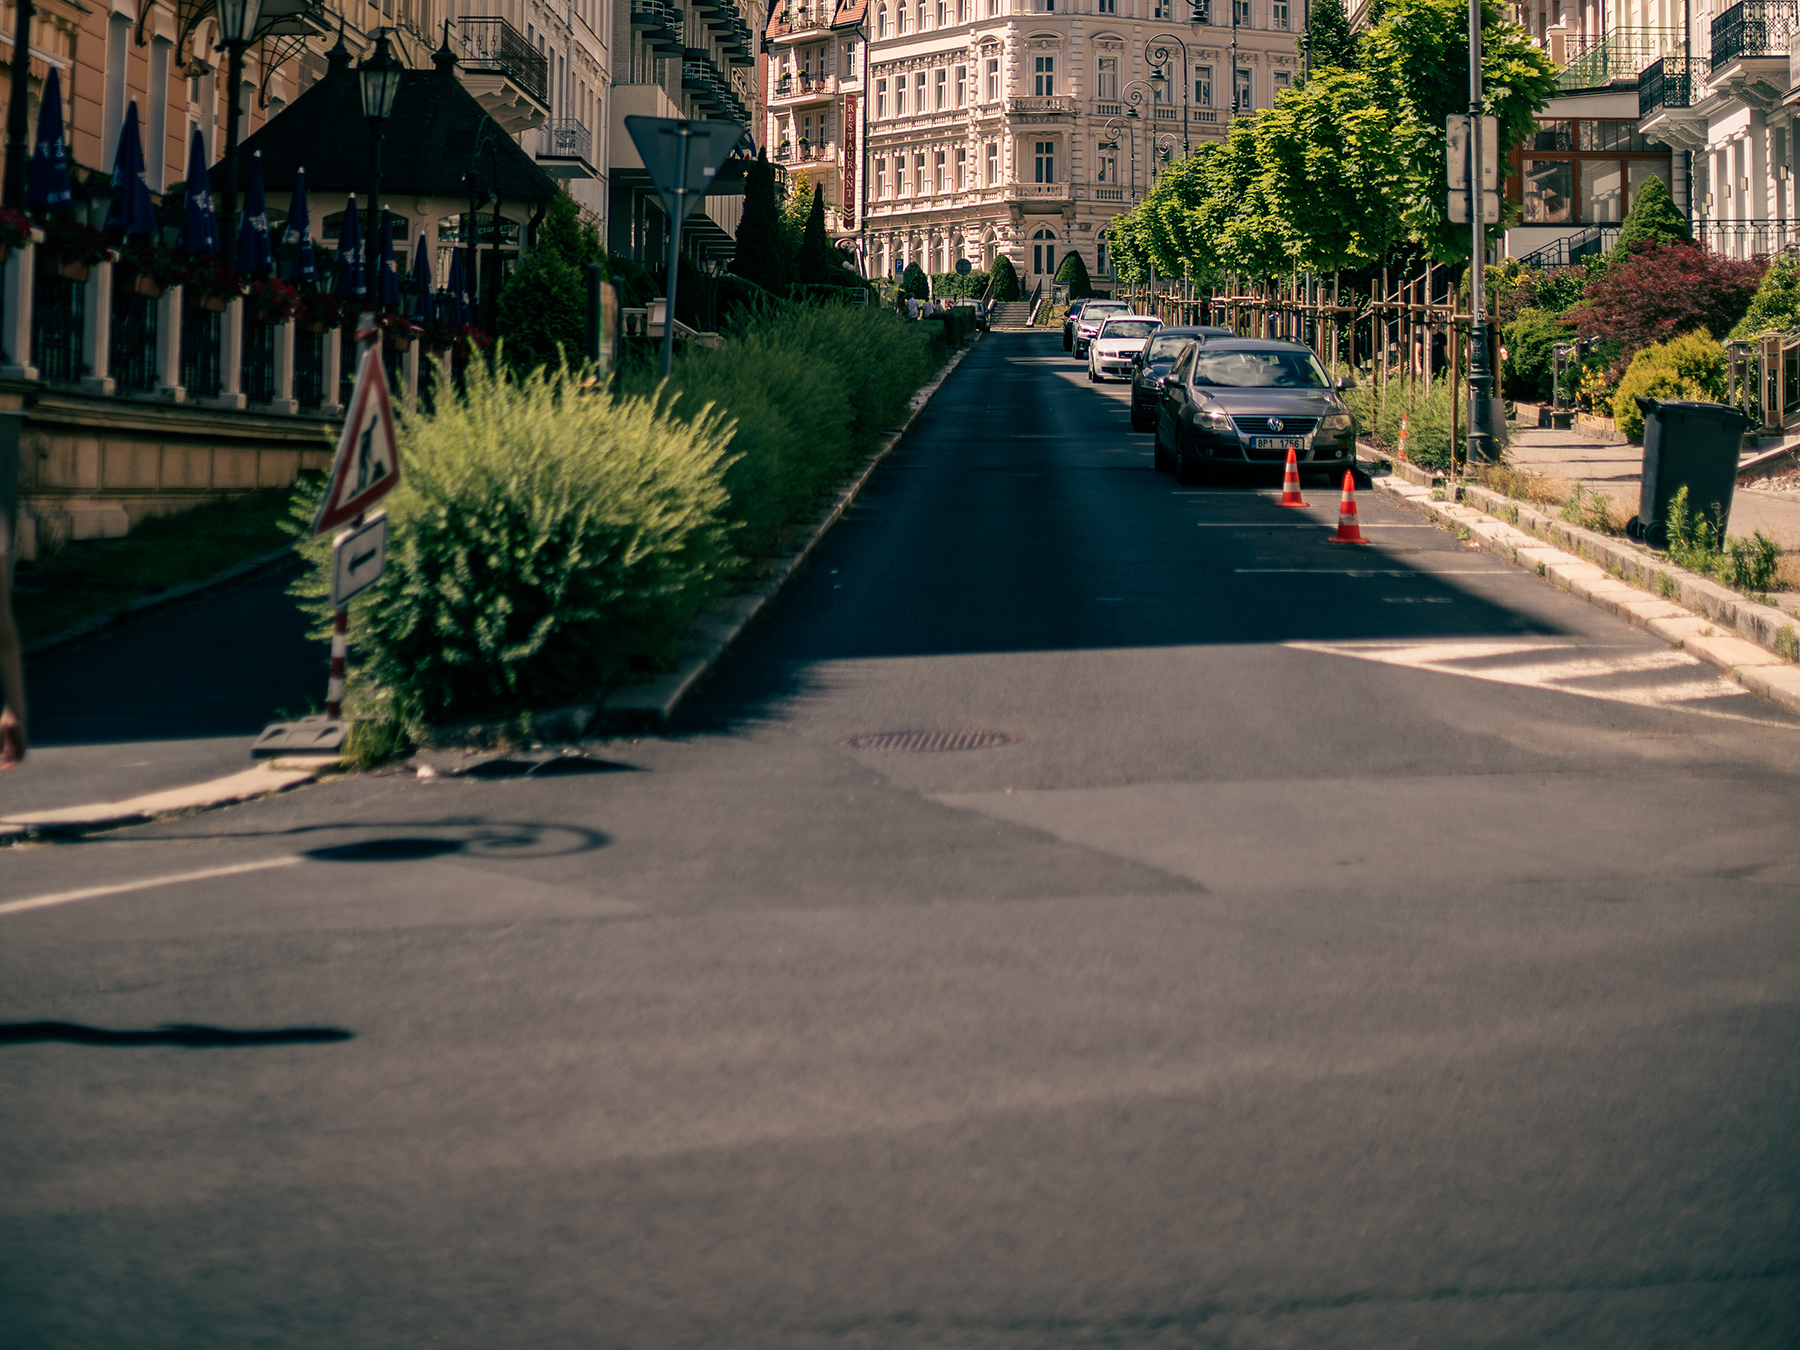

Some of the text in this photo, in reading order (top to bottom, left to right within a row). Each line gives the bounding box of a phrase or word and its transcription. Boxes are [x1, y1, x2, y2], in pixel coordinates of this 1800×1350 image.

[846, 103, 855, 198] RESTAURANT
[897, 260, 903, 269] P
[1258, 439, 1273, 448] 8P1
[1280, 439, 1300, 449] 1756
